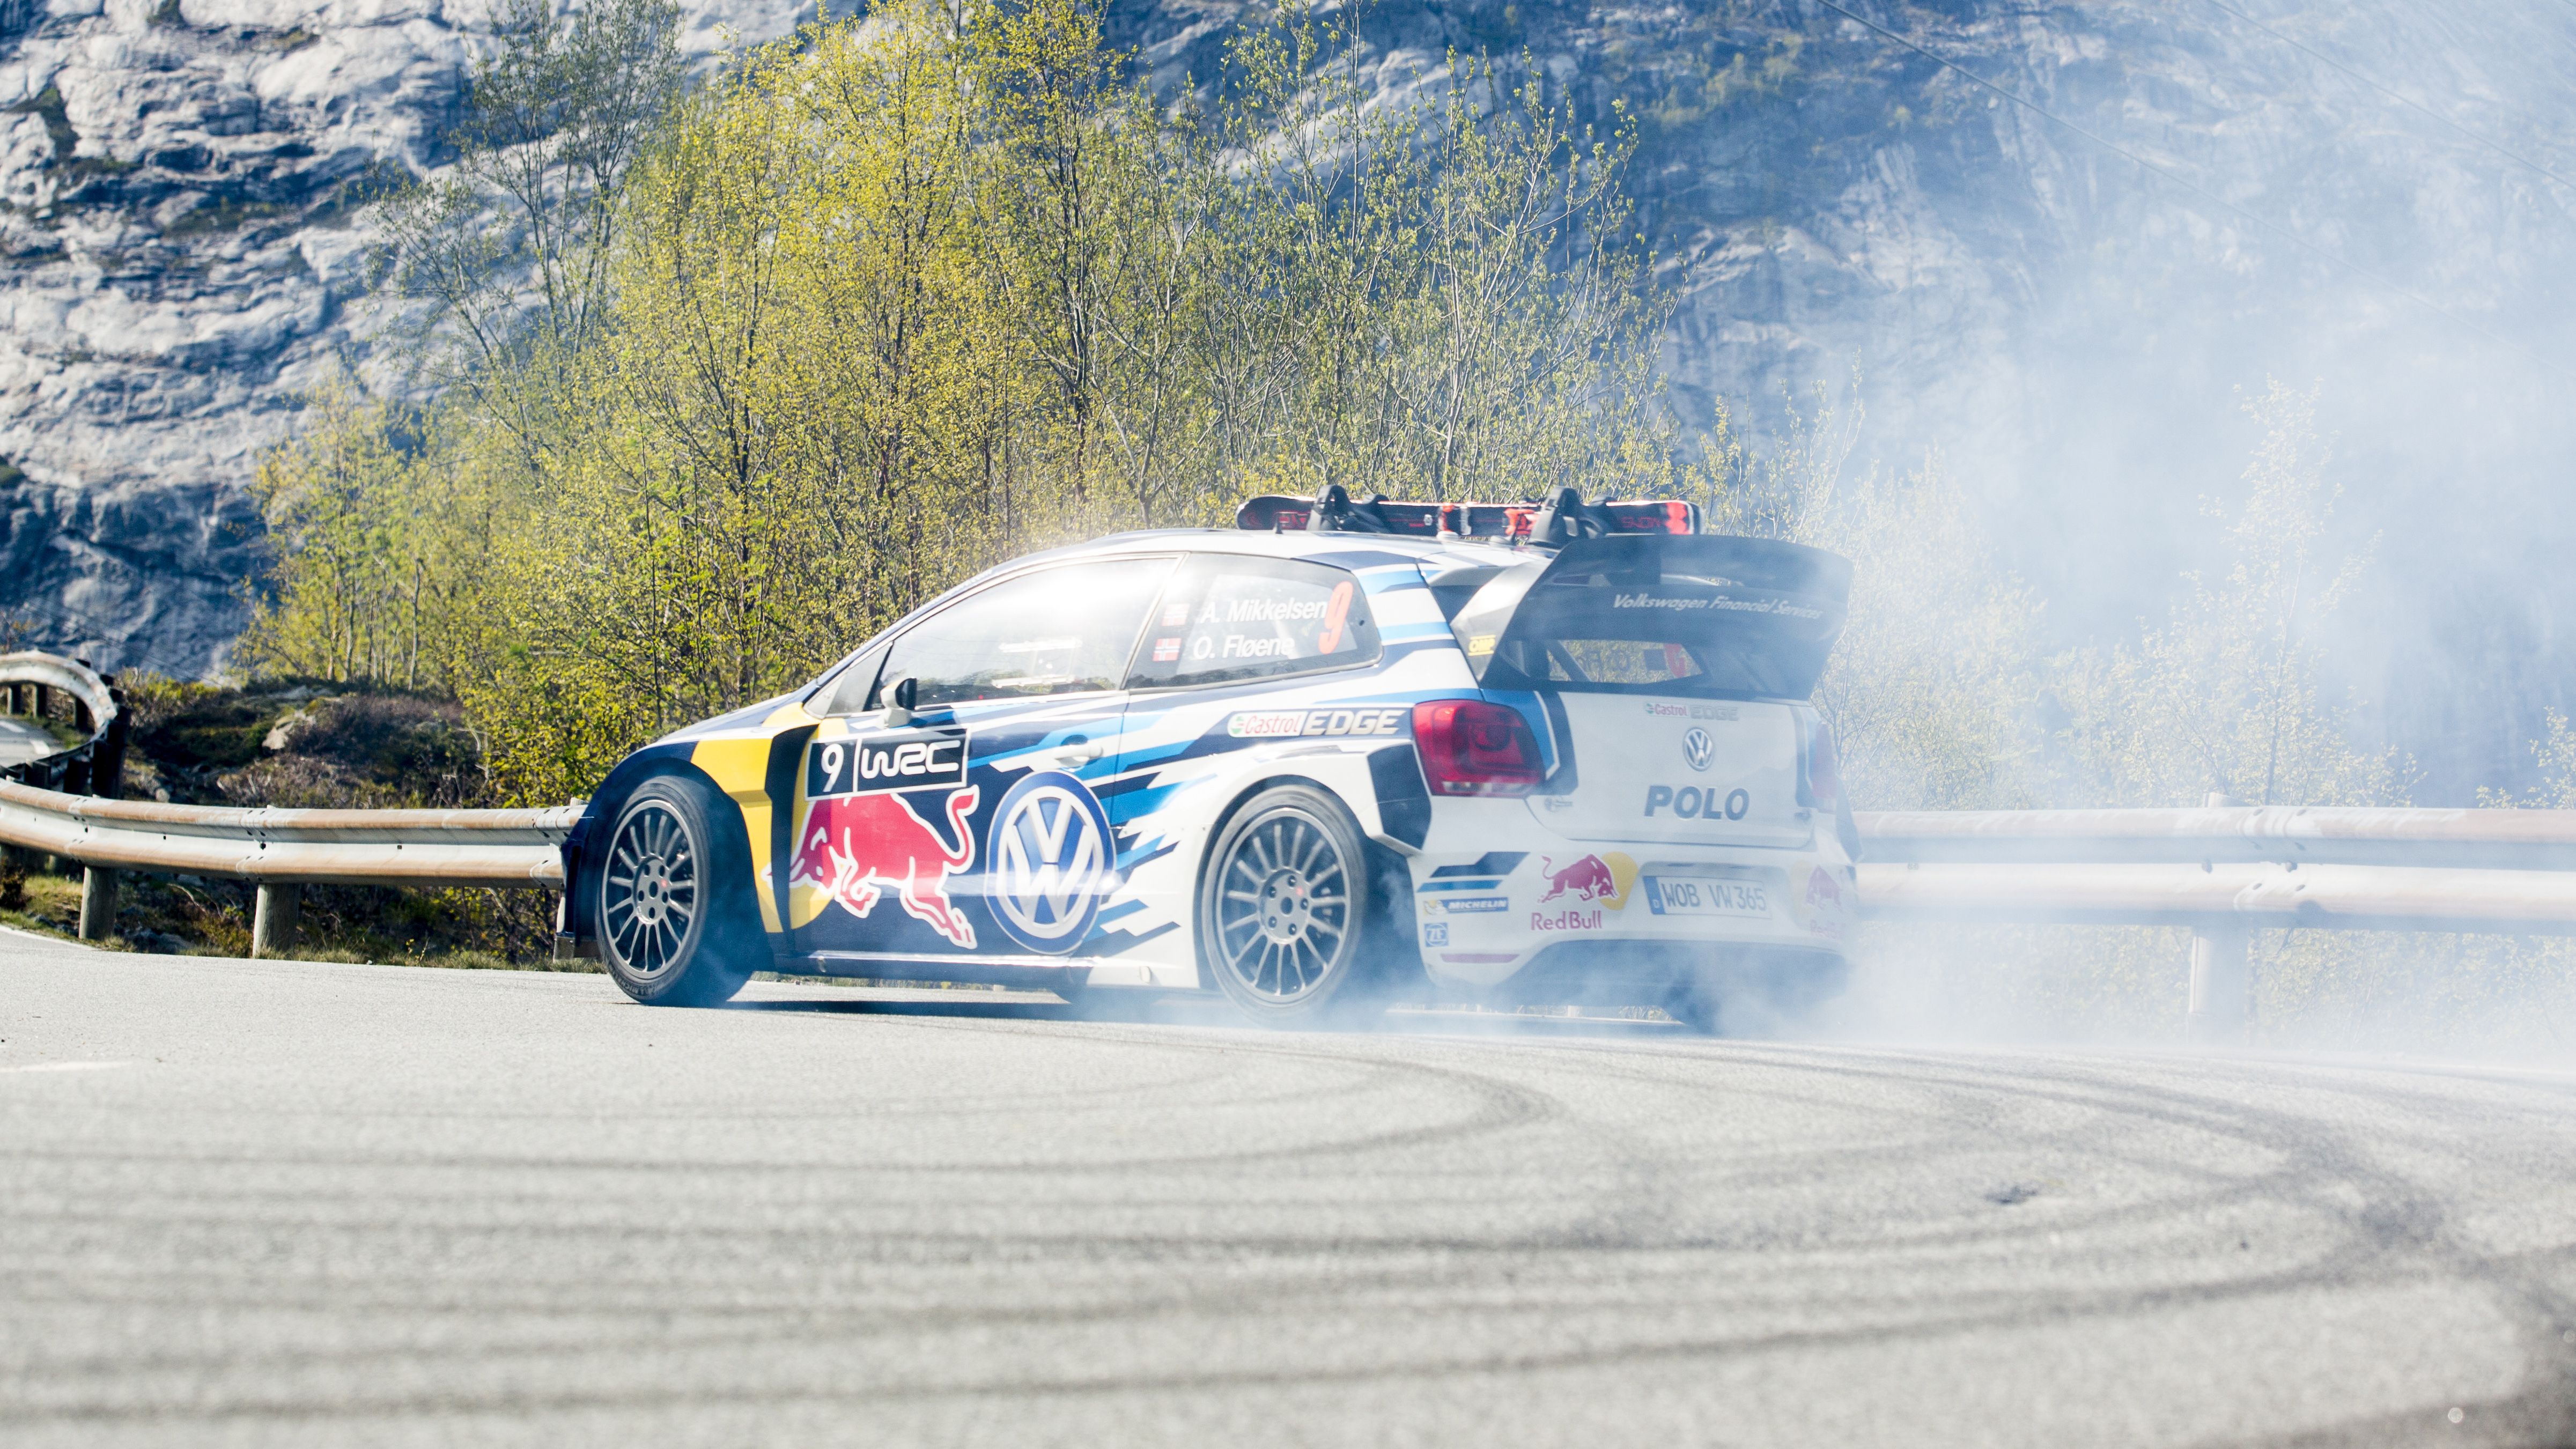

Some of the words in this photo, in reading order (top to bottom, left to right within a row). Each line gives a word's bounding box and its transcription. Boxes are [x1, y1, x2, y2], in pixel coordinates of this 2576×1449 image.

[1200, 602, 1220, 623] A.
[1227, 597, 1328, 623] Mikkelsen
[1318, 581, 1354, 655] 9
[1613, 594, 1709, 611] Volkswagen
[1709, 595, 1774, 613] Financial
[1773, 600, 1824, 619] Services
[1193, 636, 1215, 660] O.
[1222, 634, 1296, 659] Fløene
[1245, 715, 1302, 734] Castrol
[1301, 710, 1407, 735] EDGE
[1655, 704, 1687, 716] Castrol
[1691, 705, 1739, 722] EDGE
[821, 743, 844, 792] 9
[861, 740, 961, 779] WRC
[1644, 785, 1750, 821] POLO
[1002, 791, 1099, 932] VW
[1449, 900, 1507, 910] MICHELIN
[1662, 883, 1701, 907] WOB
